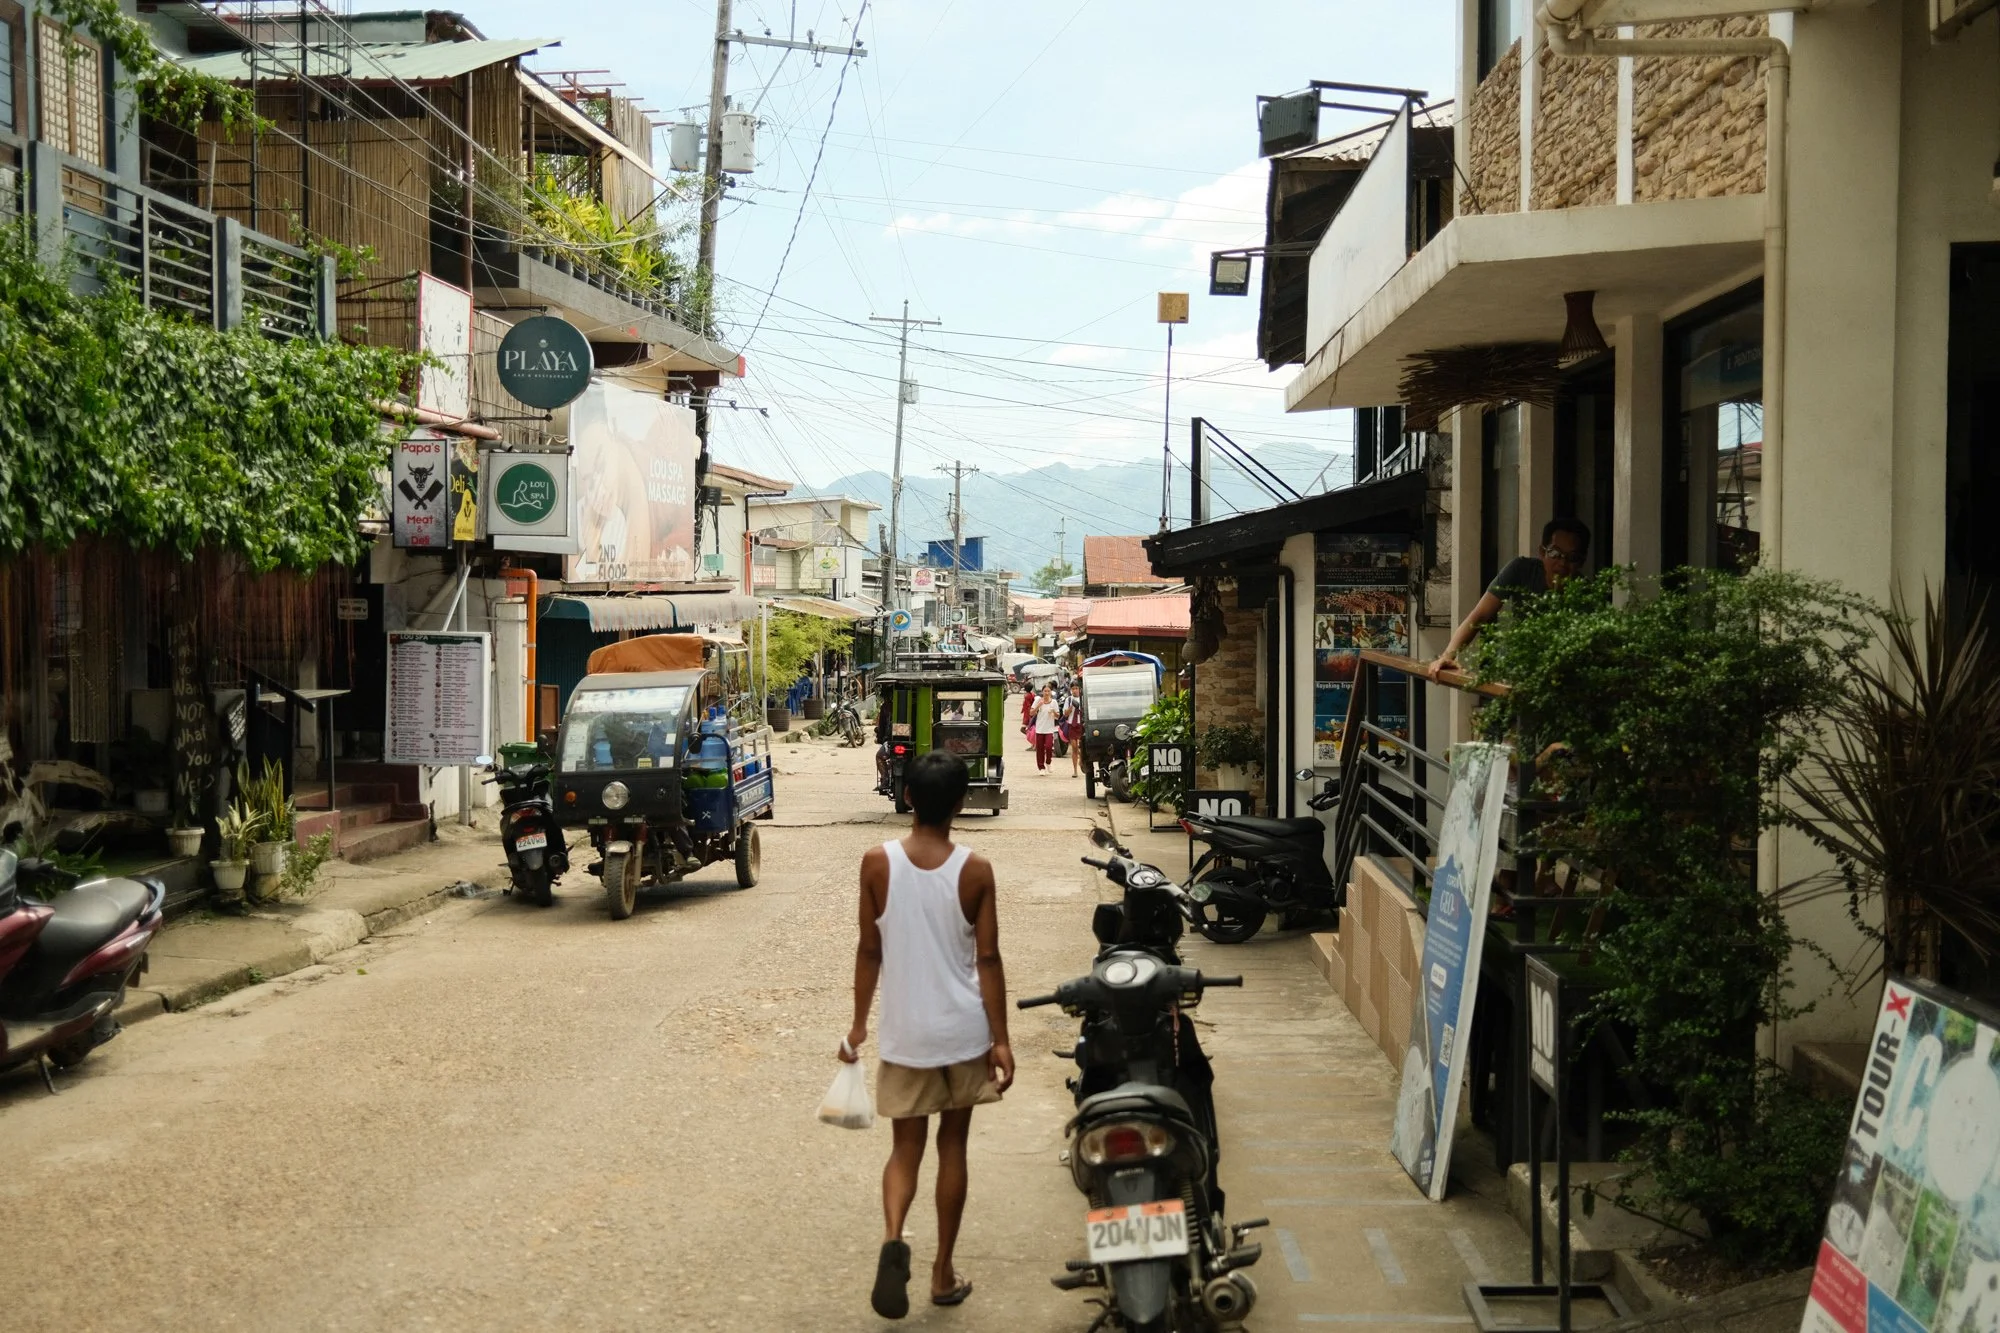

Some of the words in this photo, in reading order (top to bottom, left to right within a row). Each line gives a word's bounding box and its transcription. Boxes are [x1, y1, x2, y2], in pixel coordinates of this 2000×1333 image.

[505, 350, 579, 371] PLAYA
[401, 442, 441, 456] Papa's
[650, 457, 666, 480] LOU
[668, 460, 683, 482] SPA
[450, 474, 465, 494] Deli
[648, 481, 687, 505] MASSAGE
[530, 492, 545, 500] SPA
[406, 515, 434, 524] Meat
[411, 536, 430, 545] Deli
[598, 543, 616, 563] 2ND
[598, 563, 628, 580] FLOOR
[175, 702, 205, 722] NOT
[174, 725, 207, 751] What
[1153, 748, 1182, 766] NO
[1153, 765, 1182, 773] PARKING
[1198, 798, 1242, 817] NO
[1530, 981, 1554, 1060] NO
[1855, 987, 1912, 1139] TOUR-X
